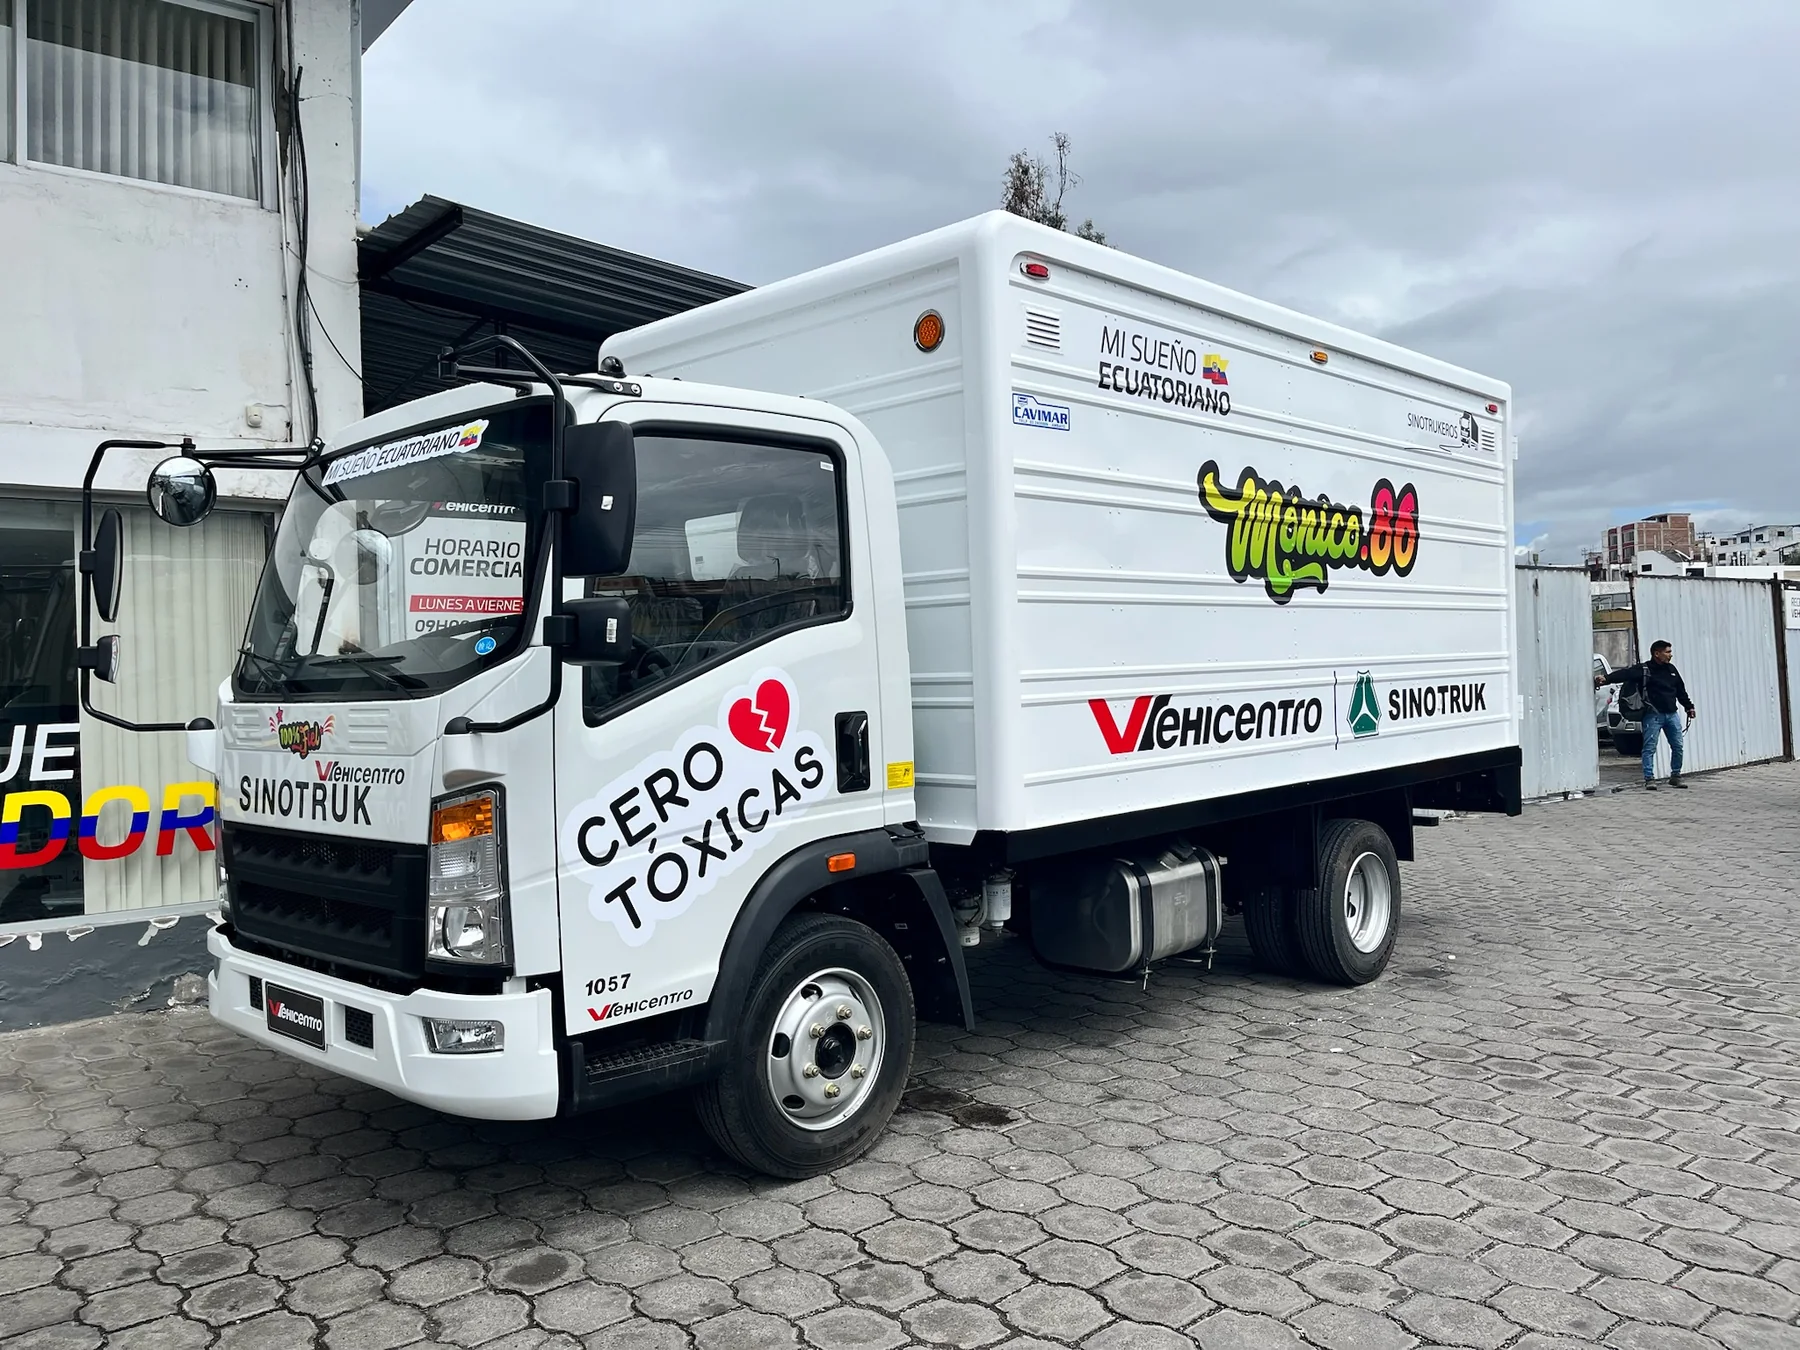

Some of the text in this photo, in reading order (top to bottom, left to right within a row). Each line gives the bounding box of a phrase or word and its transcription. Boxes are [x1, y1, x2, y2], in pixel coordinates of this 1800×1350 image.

[1100, 325, 1197, 376] MI SUEÑO
[1098, 361, 1231, 416] ECUATORIANO
[1014, 406, 1068, 425] CAVIMAR
[1407, 412, 1458, 439] SINOTRUKEROS
[325, 431, 461, 481] MI SUEÑO ECUATORIANO
[424, 538, 521, 559] HORARIO
[418, 598, 463, 610] LUNES
[464, 599, 475, 611] A
[1388, 682, 1487, 721] SINOTRUK
[0, 781, 216, 870] DOR
[239, 775, 372, 826] SINOTRUK
[577, 741, 724, 867] CERO
[604, 745, 824, 929] TÓXICAS
[585, 973, 631, 997] 1057
